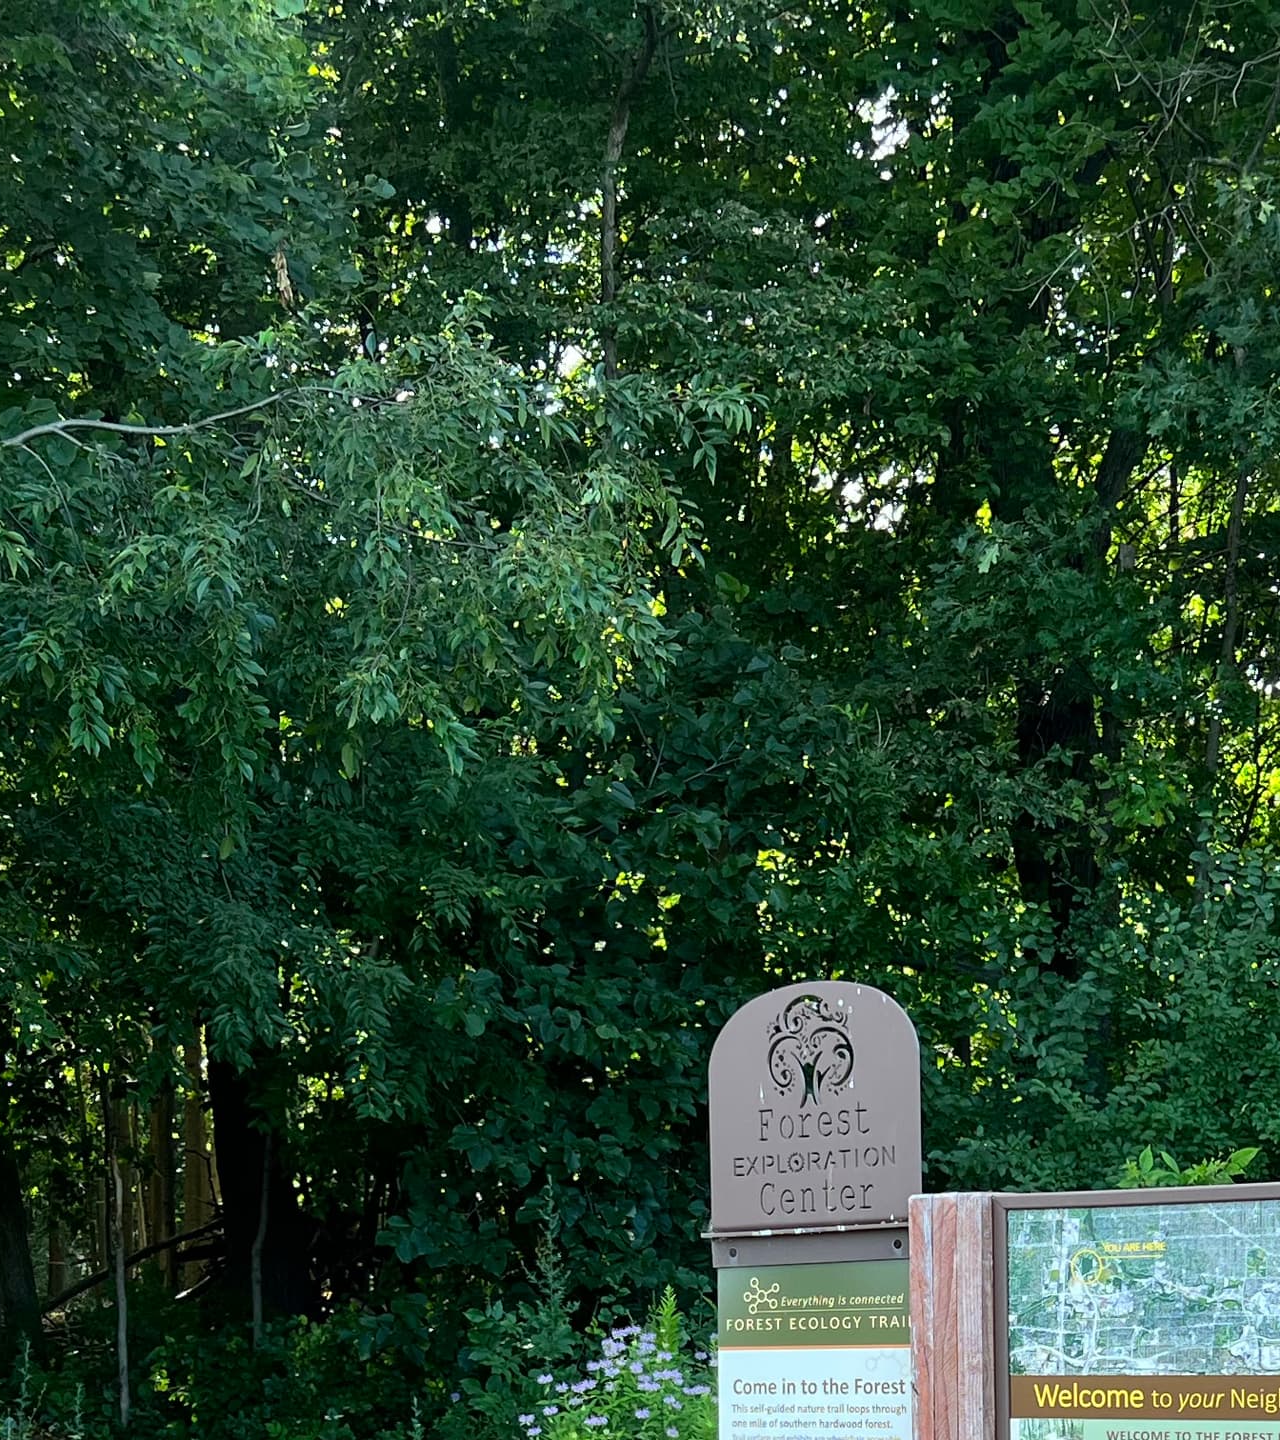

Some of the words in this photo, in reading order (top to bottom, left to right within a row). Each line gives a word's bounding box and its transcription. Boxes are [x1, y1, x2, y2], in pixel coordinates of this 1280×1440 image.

[758, 1102, 870, 1141] Forest
[733, 1146, 896, 1177] EXPLORATION
[760, 1180, 874, 1216] Center
[781, 1296, 834, 1307] Everything
[838, 1295, 846, 1305] is
[849, 1293, 904, 1305] connected
[726, 1319, 783, 1331] FOREST
[789, 1317, 862, 1330] ECOLOGY
[733, 1379, 777, 1395] Come
[783, 1379, 796, 1394] in
[801, 1380, 817, 1394] to
[822, 1378, 849, 1394] the
[855, 1379, 906, 1394] Forest
[1034, 1383, 1144, 1408] Welcome
[1152, 1390, 1171, 1408] to
[1178, 1392, 1224, 1412] your
[732, 1404, 748, 1414] This
[750, 1404, 795, 1415] self-guided
[797, 1405, 825, 1413] nature
[828, 1404, 844, 1413] trail
[847, 1404, 870, 1415] loops
[872, 1404, 907, 1415] through
